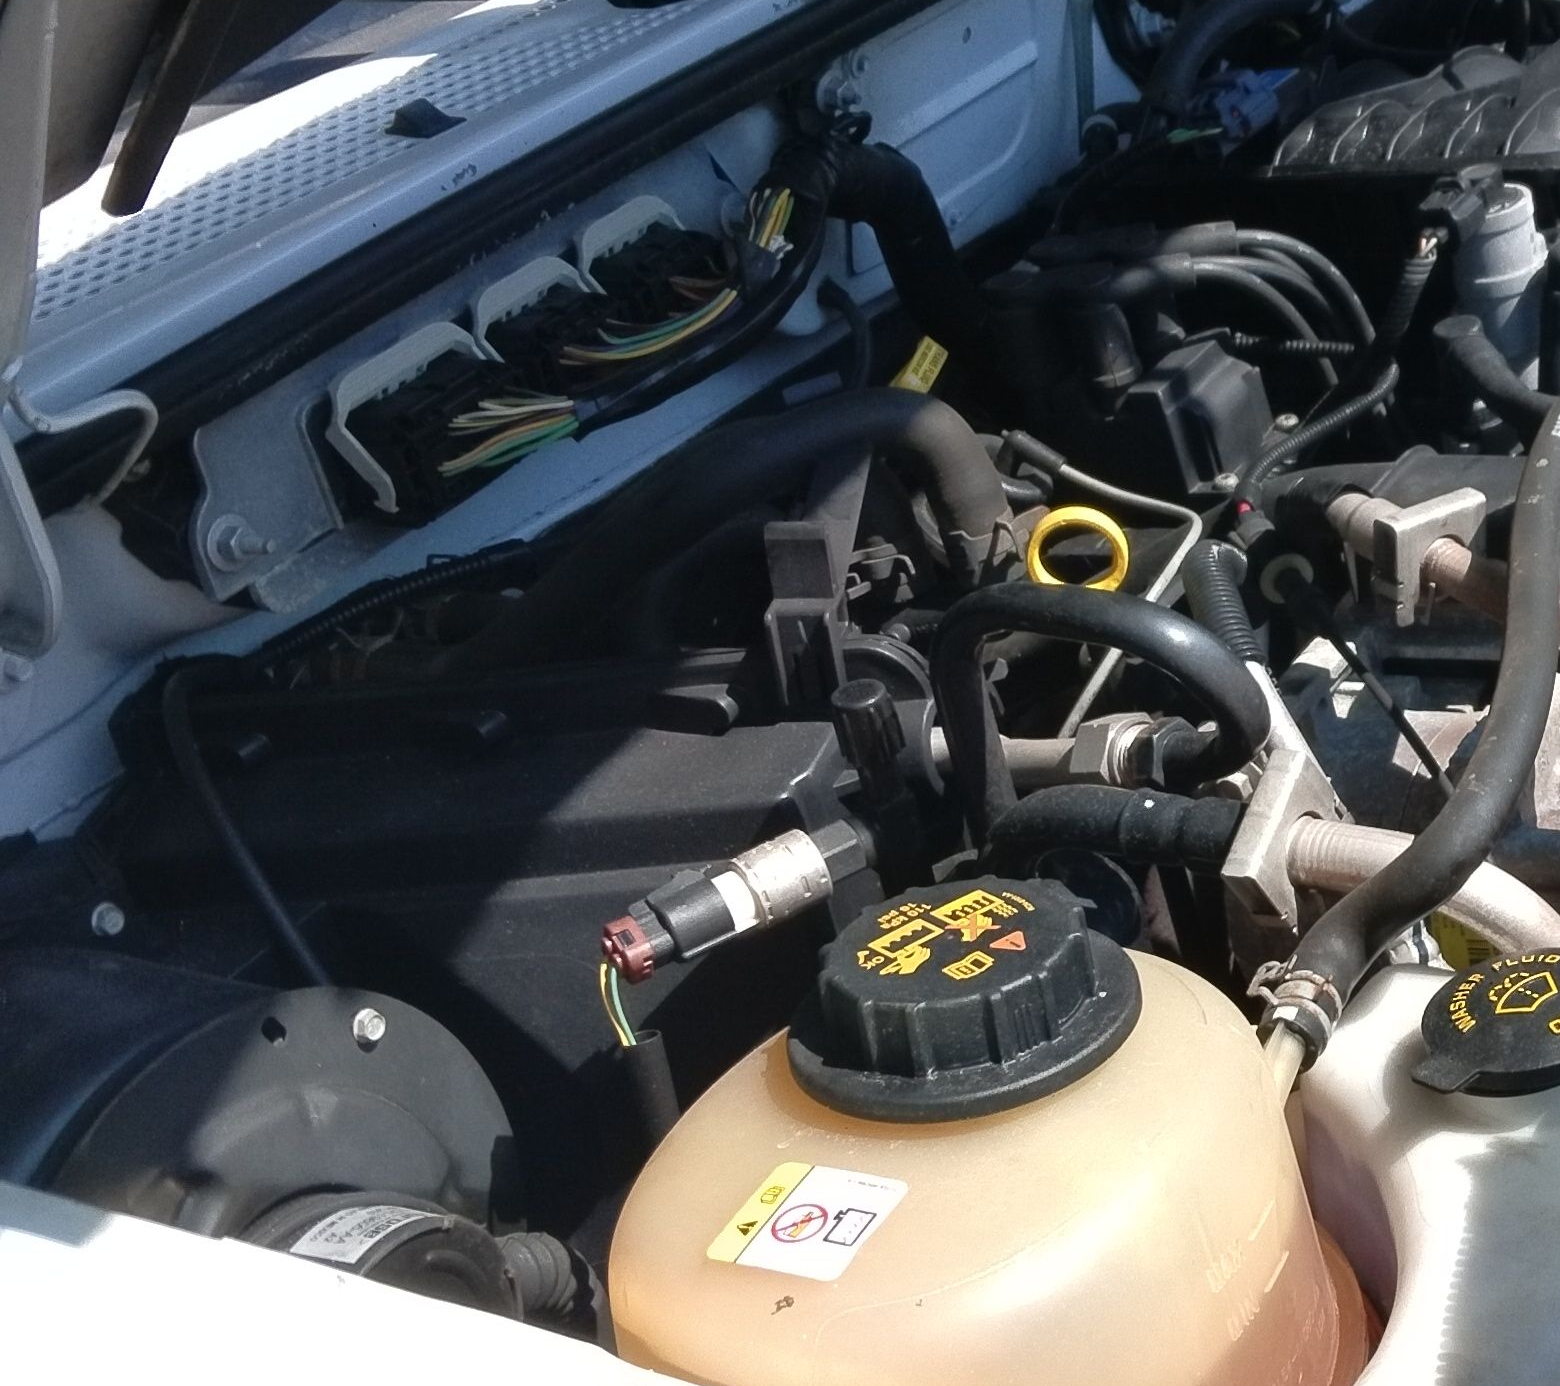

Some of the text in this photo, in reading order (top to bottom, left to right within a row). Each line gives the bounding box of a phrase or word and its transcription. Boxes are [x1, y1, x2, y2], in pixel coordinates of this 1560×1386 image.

[906, 903, 932, 917] 110
[861, 955, 885, 970] OK
[1449, 973, 1485, 1033] WASHER
